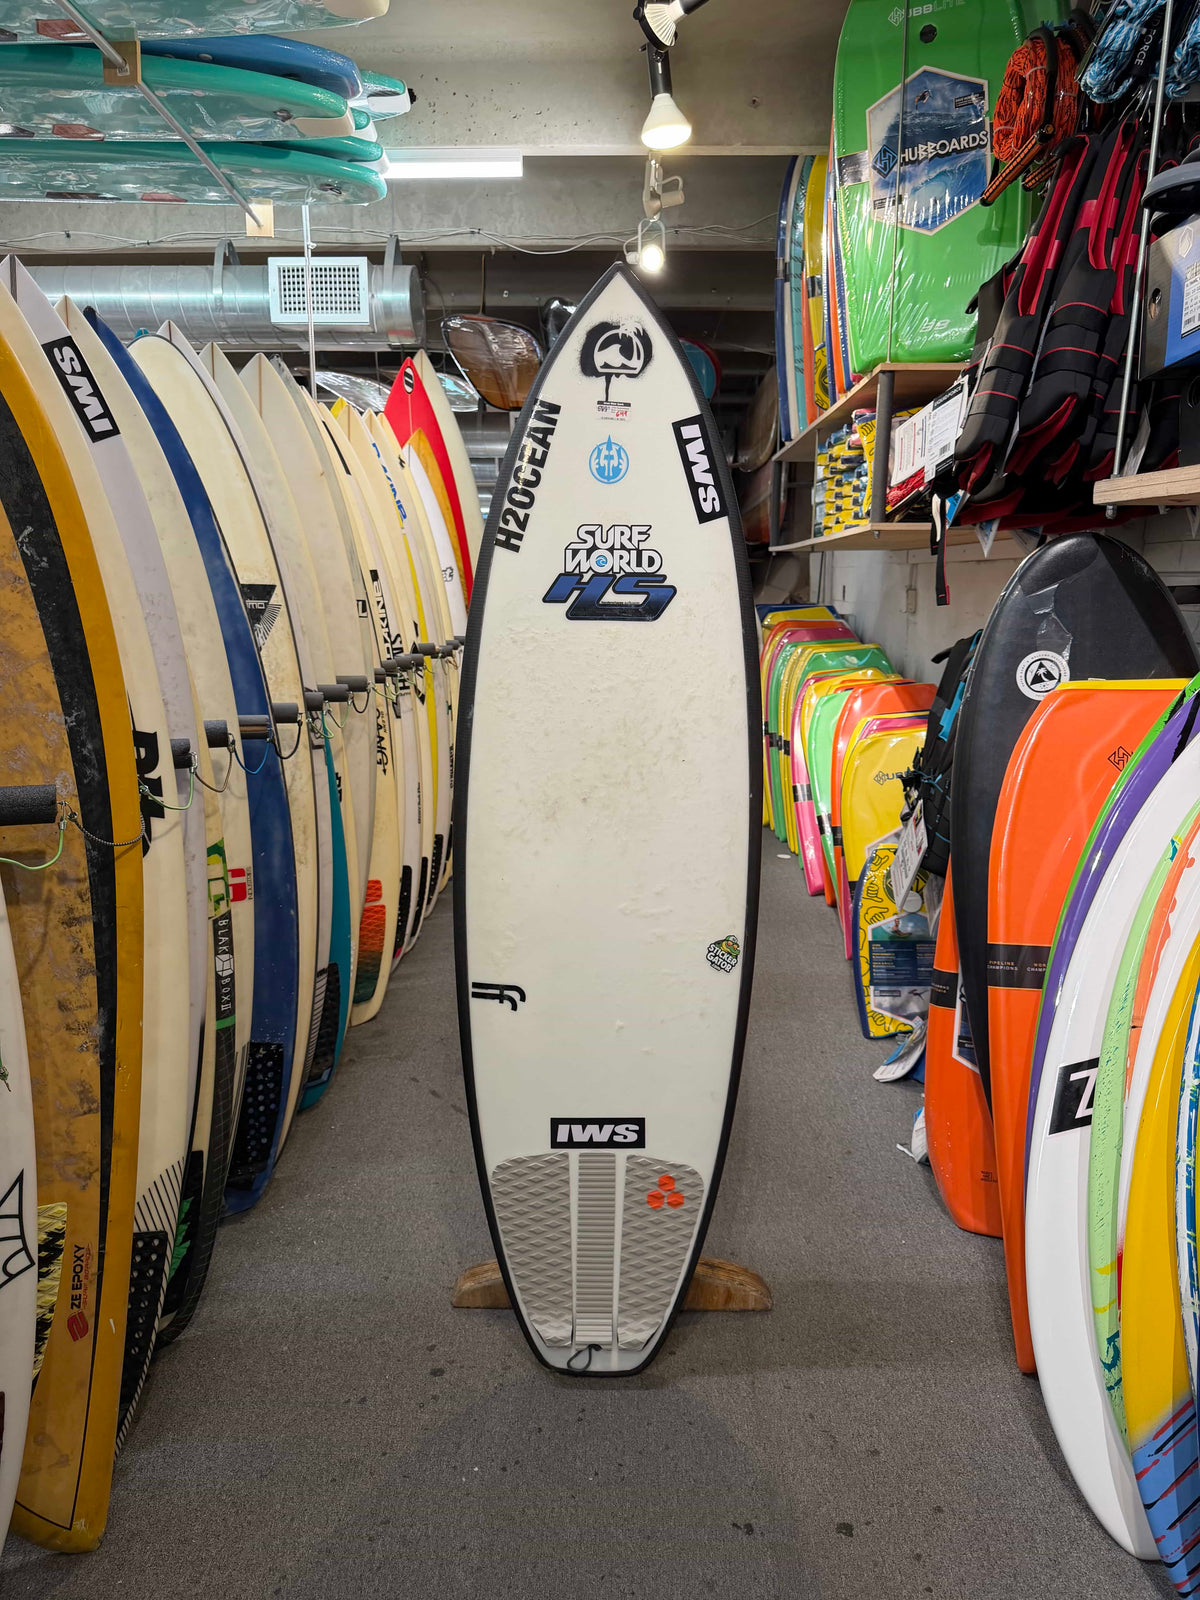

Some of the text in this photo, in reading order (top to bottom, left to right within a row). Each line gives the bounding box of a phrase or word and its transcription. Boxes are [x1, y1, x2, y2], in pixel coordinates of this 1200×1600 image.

[900, 130, 989, 163] HUBBOARDS
[53, 346, 113, 433] IWS
[680, 424, 720, 513] IWS
[565, 524, 652, 549] SURF
[565, 548, 663, 574] WORLD
[542, 573, 677, 621] HS
[217, 918, 229, 953] BLAK
[707, 953, 732, 972] GATOR
[709, 944, 737, 967] STICKER
[556, 1124, 639, 1143] IWS
[70, 1244, 85, 1310] ZE EPOXY
